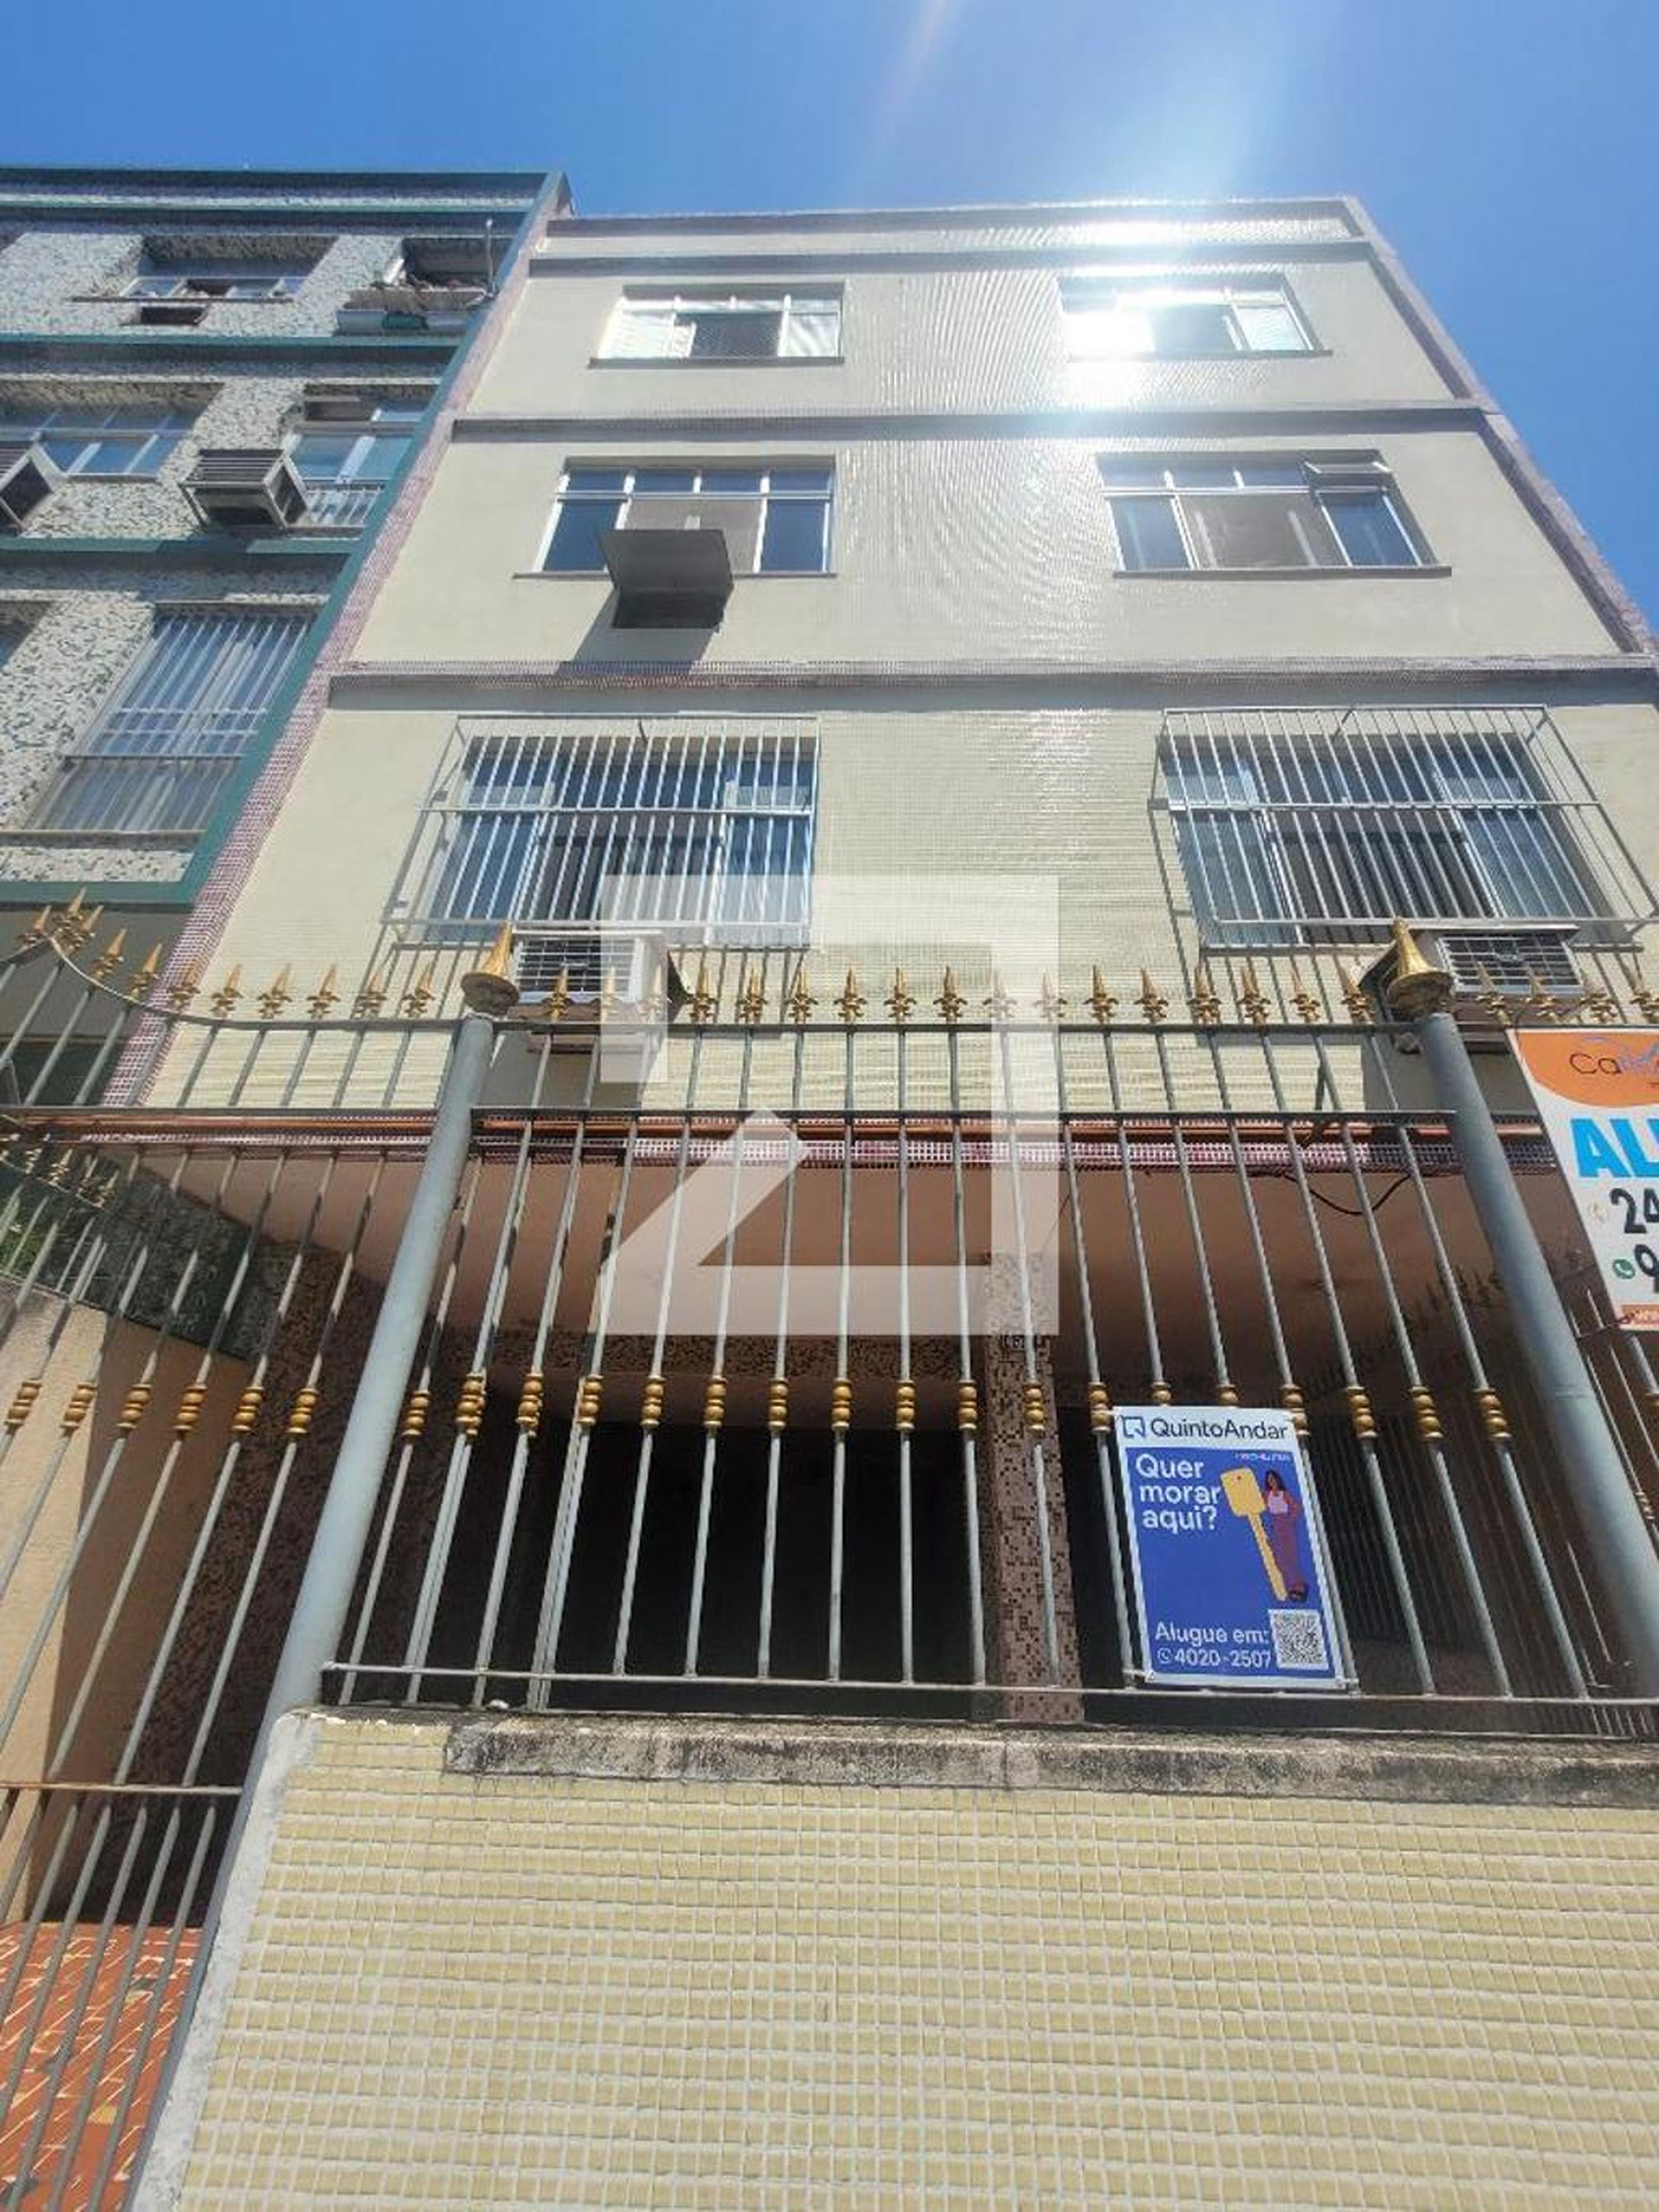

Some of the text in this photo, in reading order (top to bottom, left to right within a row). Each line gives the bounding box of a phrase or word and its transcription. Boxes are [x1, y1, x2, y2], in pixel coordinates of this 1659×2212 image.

[1150, 1418, 1288, 1439] QuintoAndar
[1135, 1453, 1204, 1479] Quer
[1140, 1485, 1221, 1504] morar
[1142, 1505, 1217, 1534] aqui?
[1155, 1621, 1270, 1647] Alugue em:
